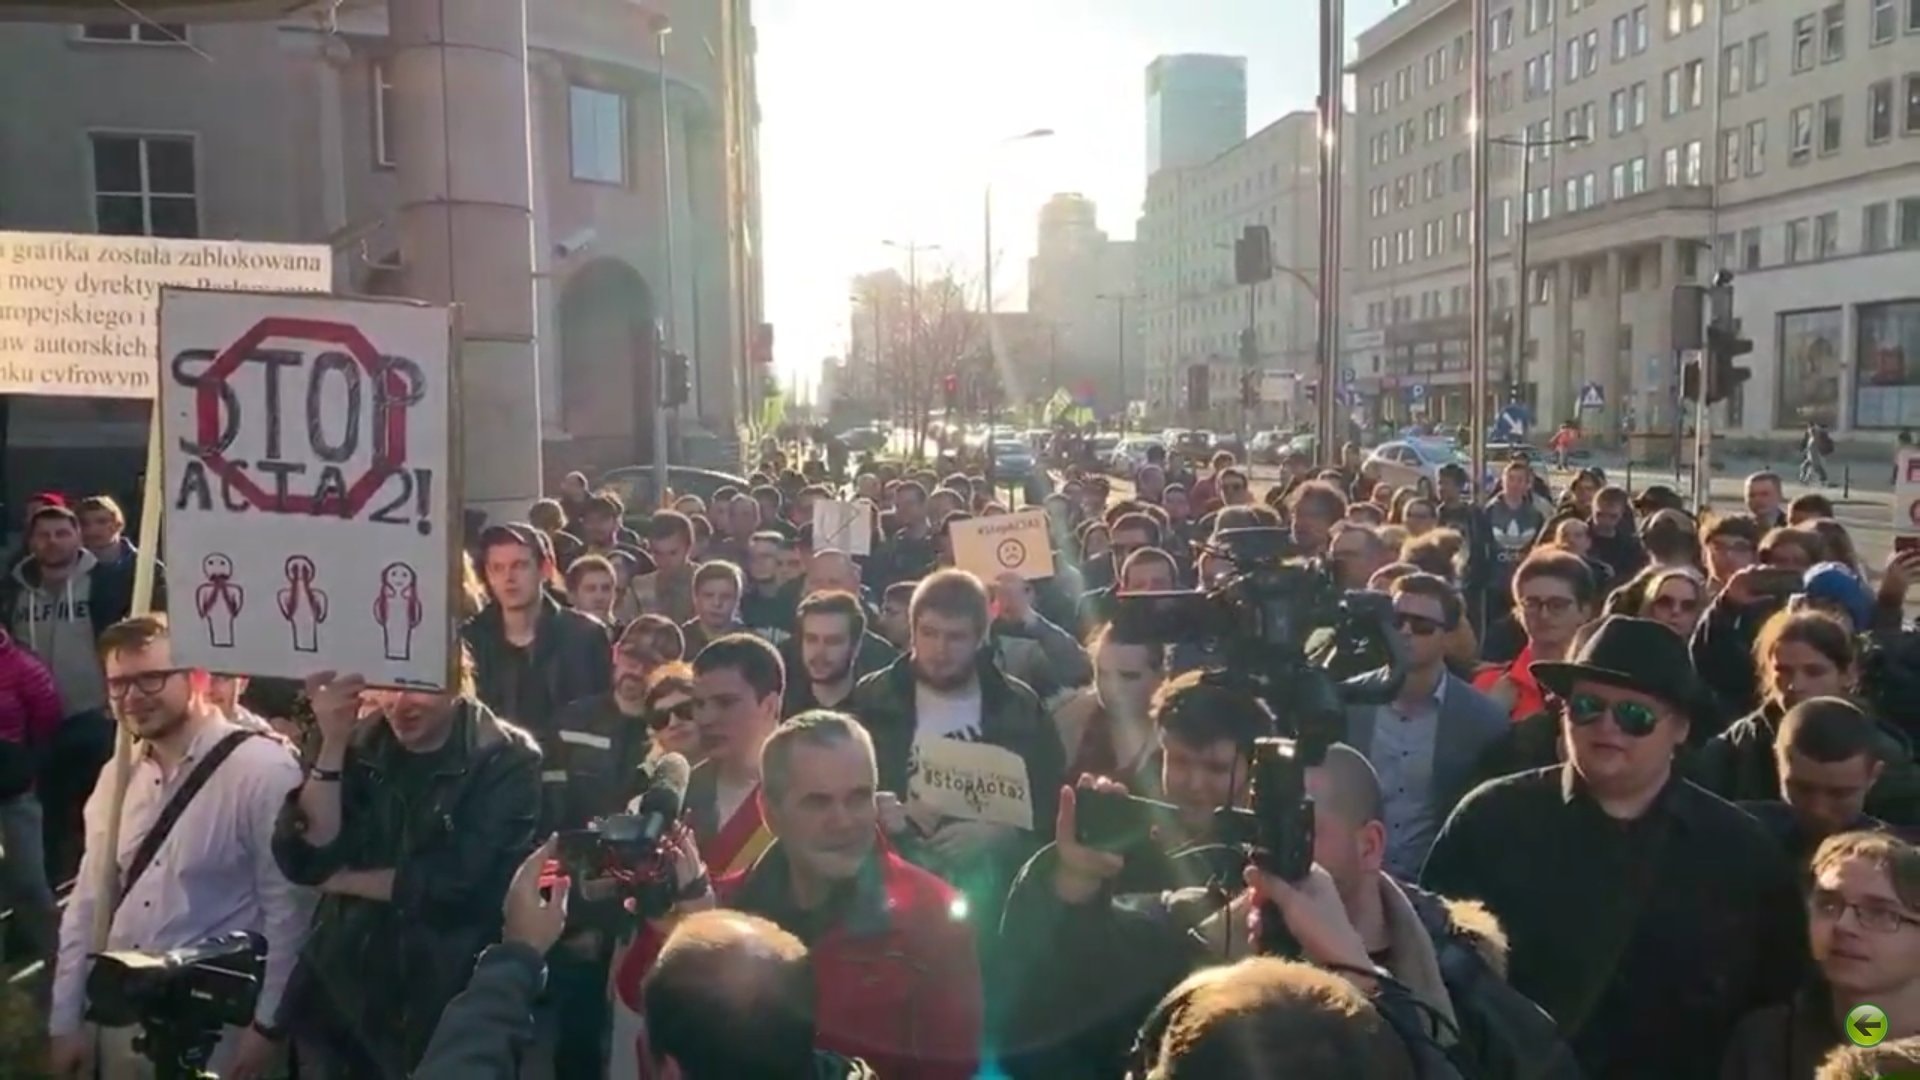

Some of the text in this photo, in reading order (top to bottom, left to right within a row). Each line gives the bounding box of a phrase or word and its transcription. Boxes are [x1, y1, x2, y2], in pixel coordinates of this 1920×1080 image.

[12, 241, 321, 272] grafika została zablokowana
[8, 273, 67, 296] mocy
[34, 335, 147, 358] autorskich
[40, 364, 150, 388] cyfrowym
[171, 348, 427, 467] STOP
[176, 459, 433, 536] ACTA 2!
